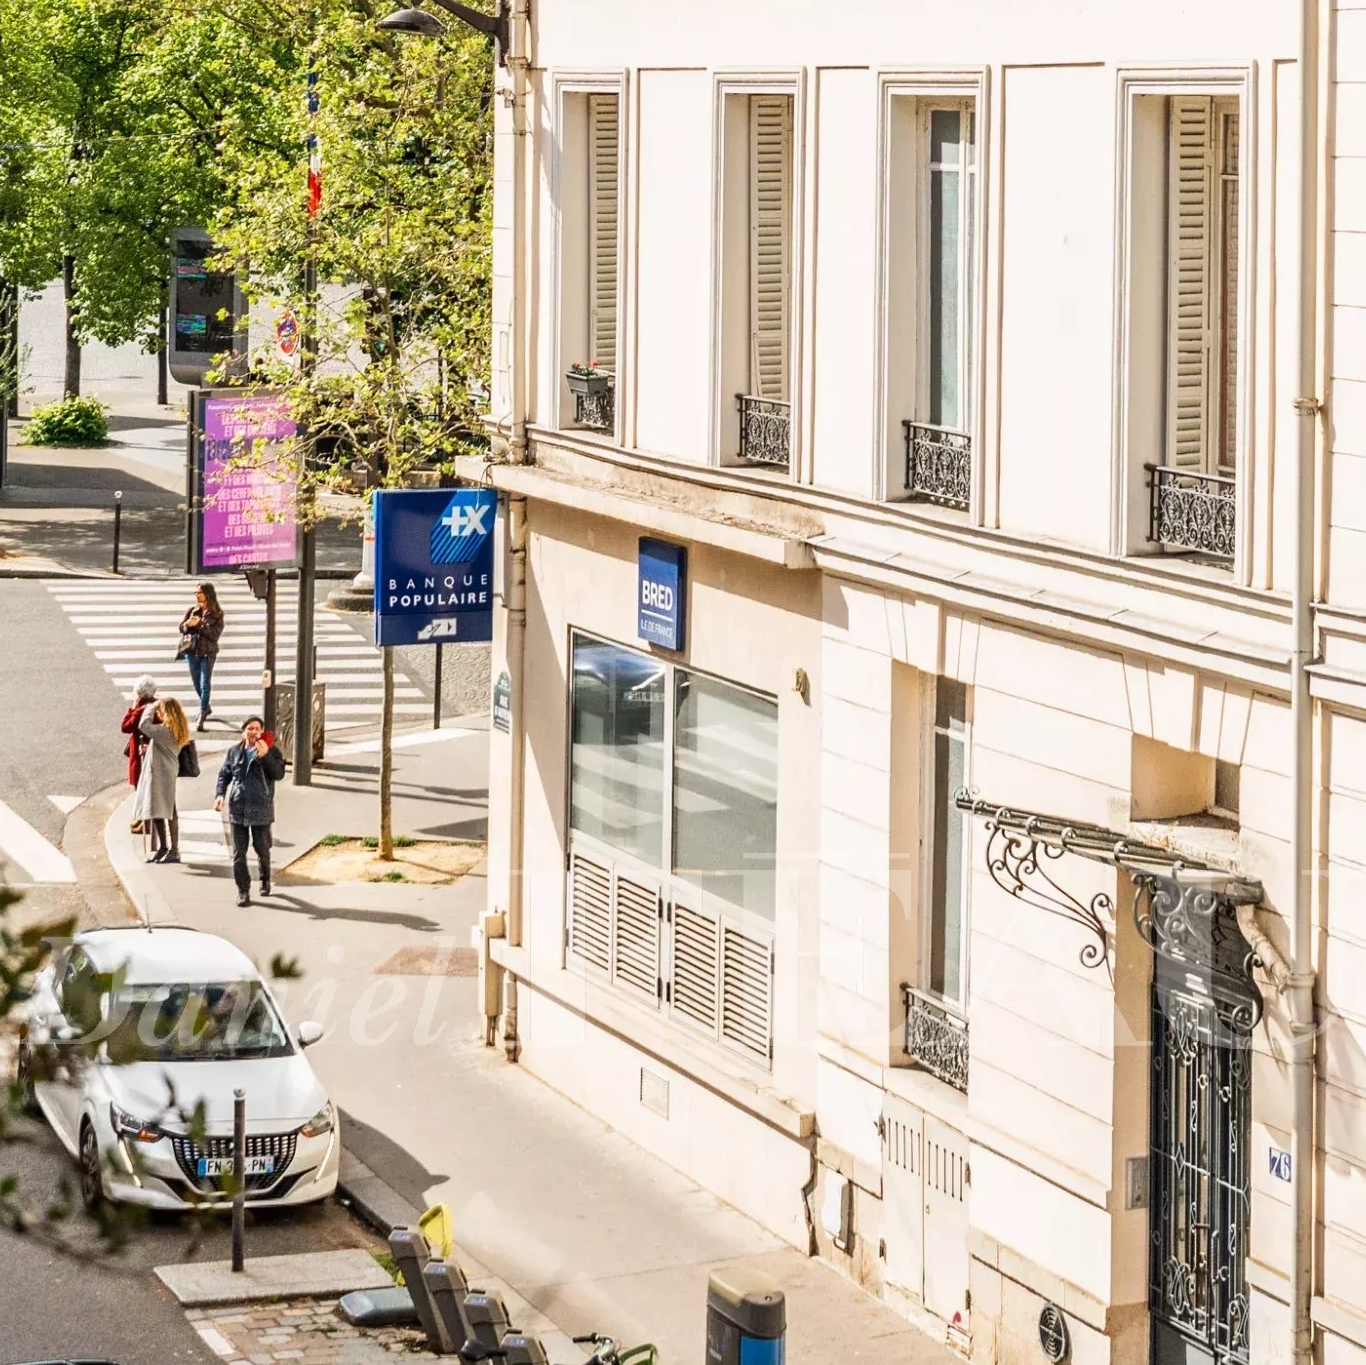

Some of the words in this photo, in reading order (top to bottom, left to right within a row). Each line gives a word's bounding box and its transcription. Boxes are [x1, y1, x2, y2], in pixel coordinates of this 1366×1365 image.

[389, 574, 488, 590] BANQUE
[389, 592, 487, 607] POPULAIRE
[642, 579, 673, 611] BRED
[1270, 1148, 1291, 1182] 76
